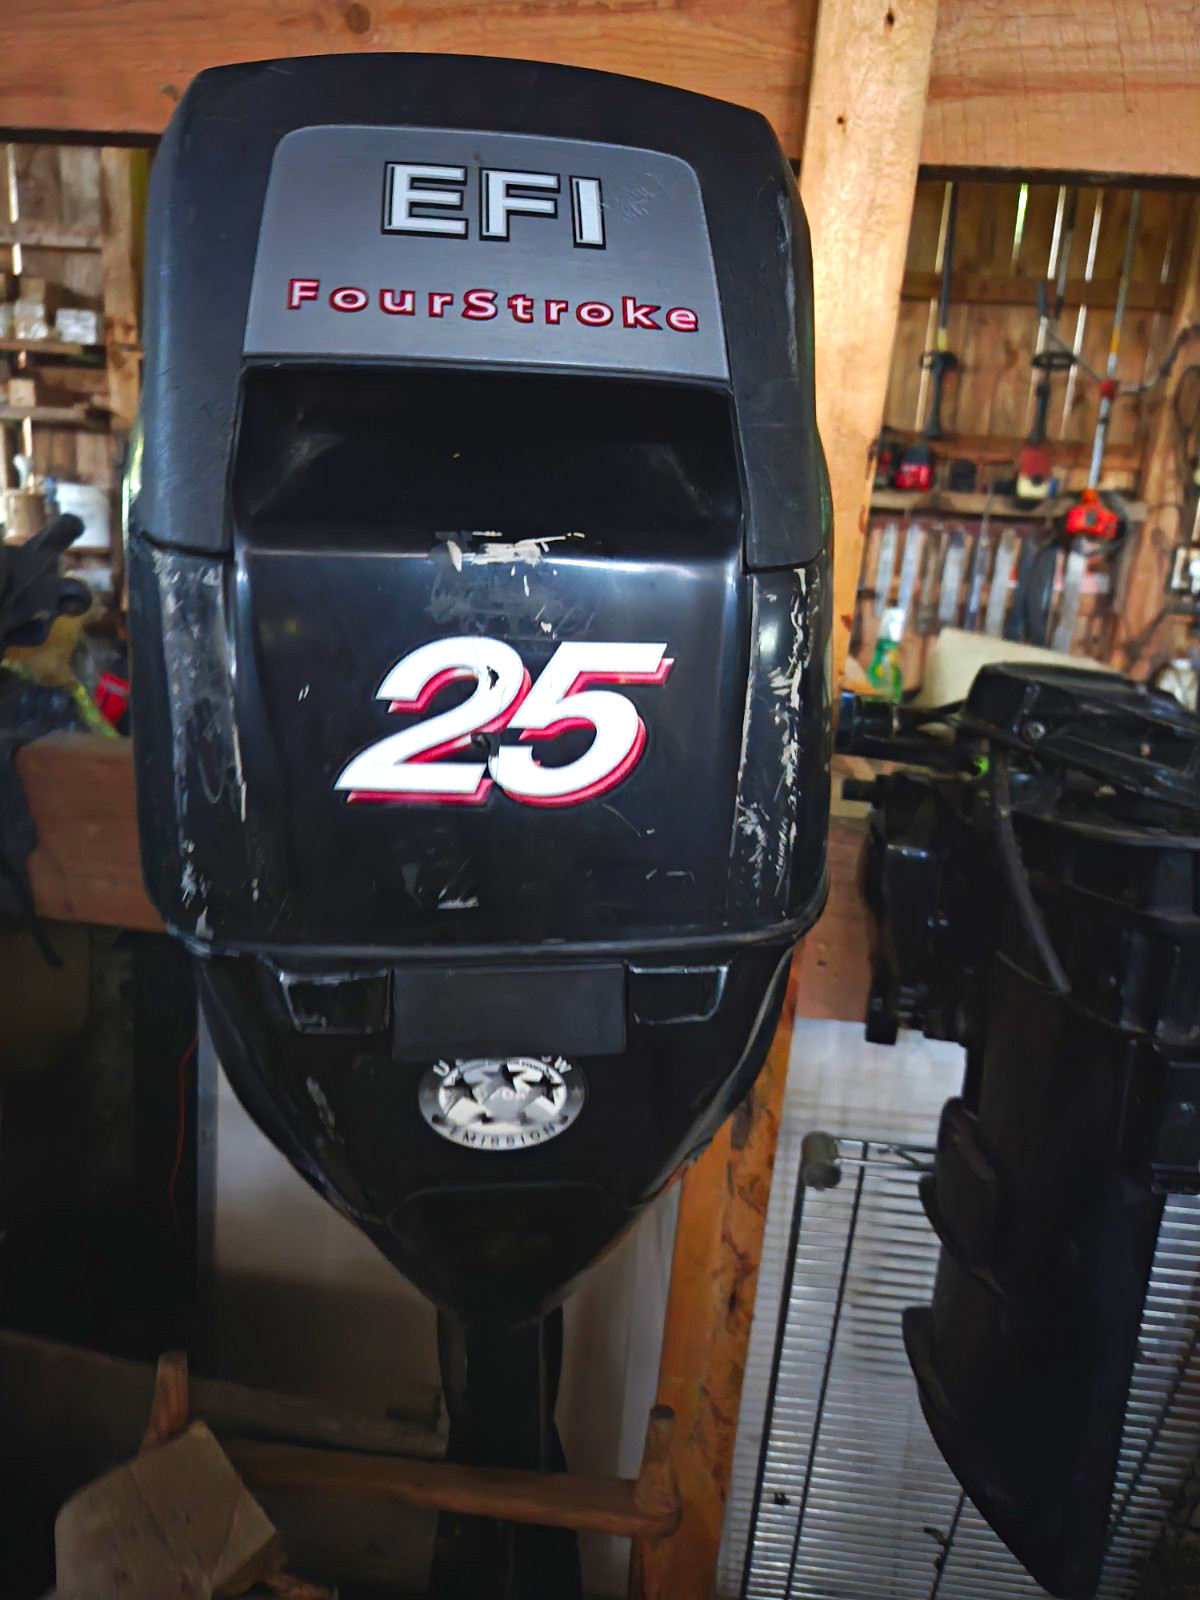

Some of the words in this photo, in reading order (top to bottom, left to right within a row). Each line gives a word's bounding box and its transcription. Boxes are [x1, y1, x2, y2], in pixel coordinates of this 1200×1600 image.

[381, 161, 606, 250] EFI
[288, 278, 699, 332] FourStroke
[334, 636, 674, 807] 25
